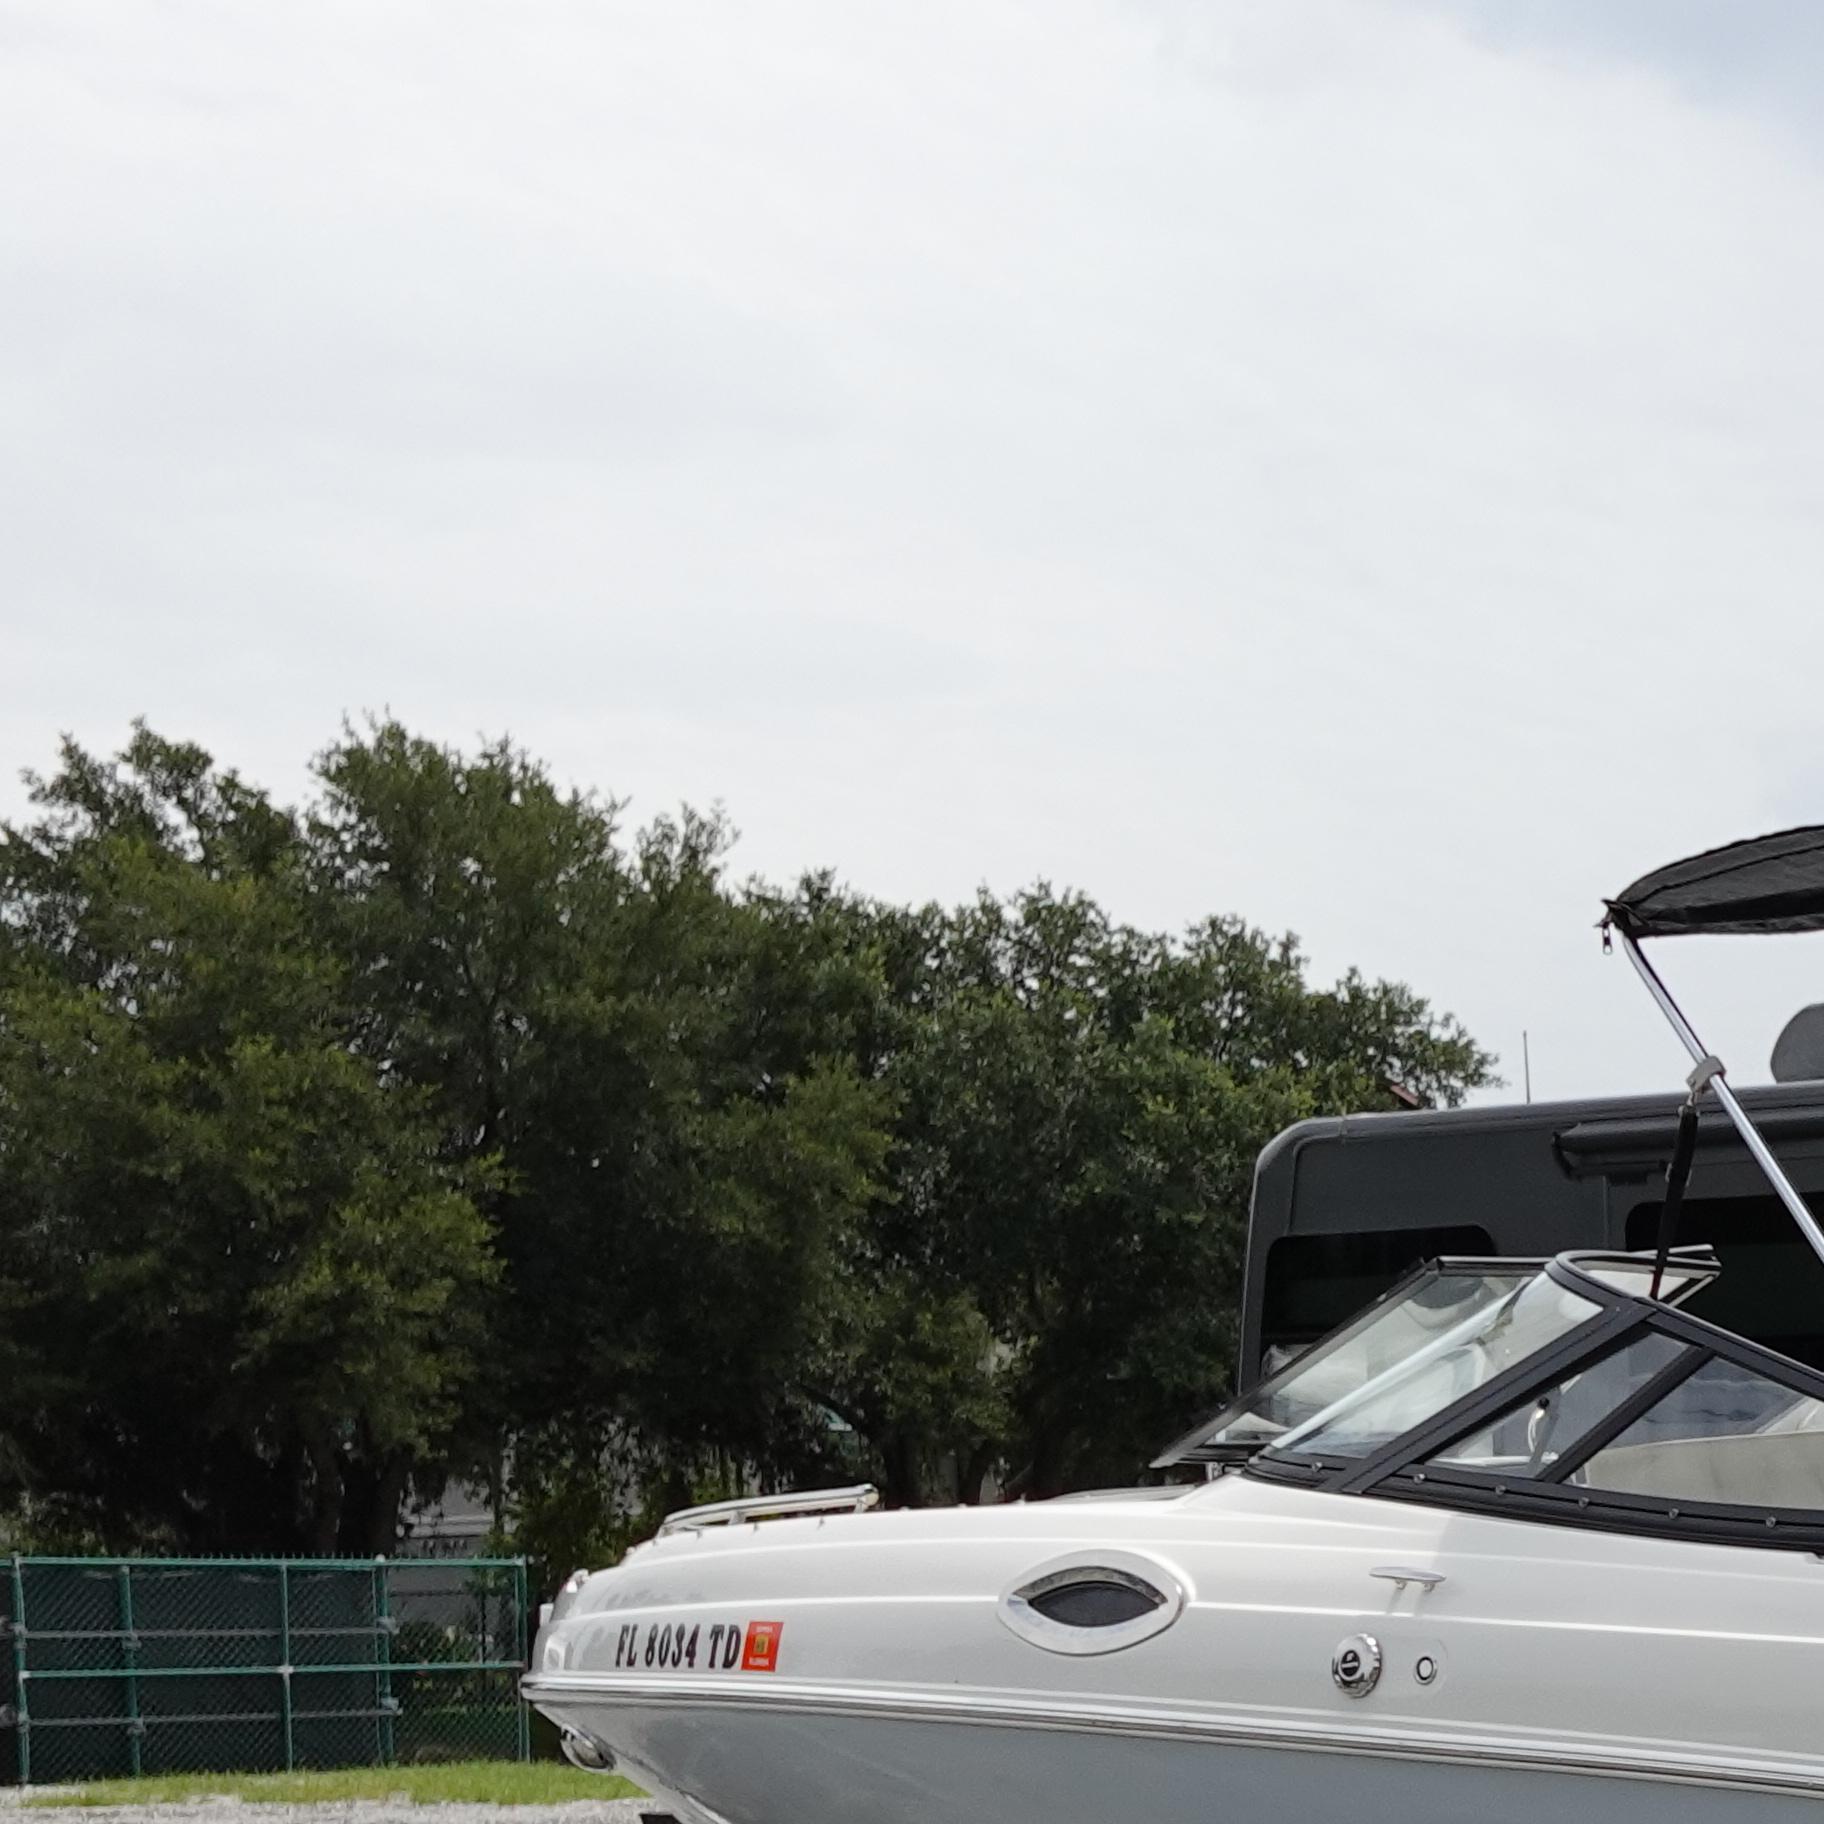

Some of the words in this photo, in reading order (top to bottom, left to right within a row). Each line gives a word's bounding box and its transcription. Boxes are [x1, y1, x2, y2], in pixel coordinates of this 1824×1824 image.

[615, 1623, 638, 1668] FL
[645, 1623, 700, 1668] 8034
[708, 1624, 742, 1669] TD
